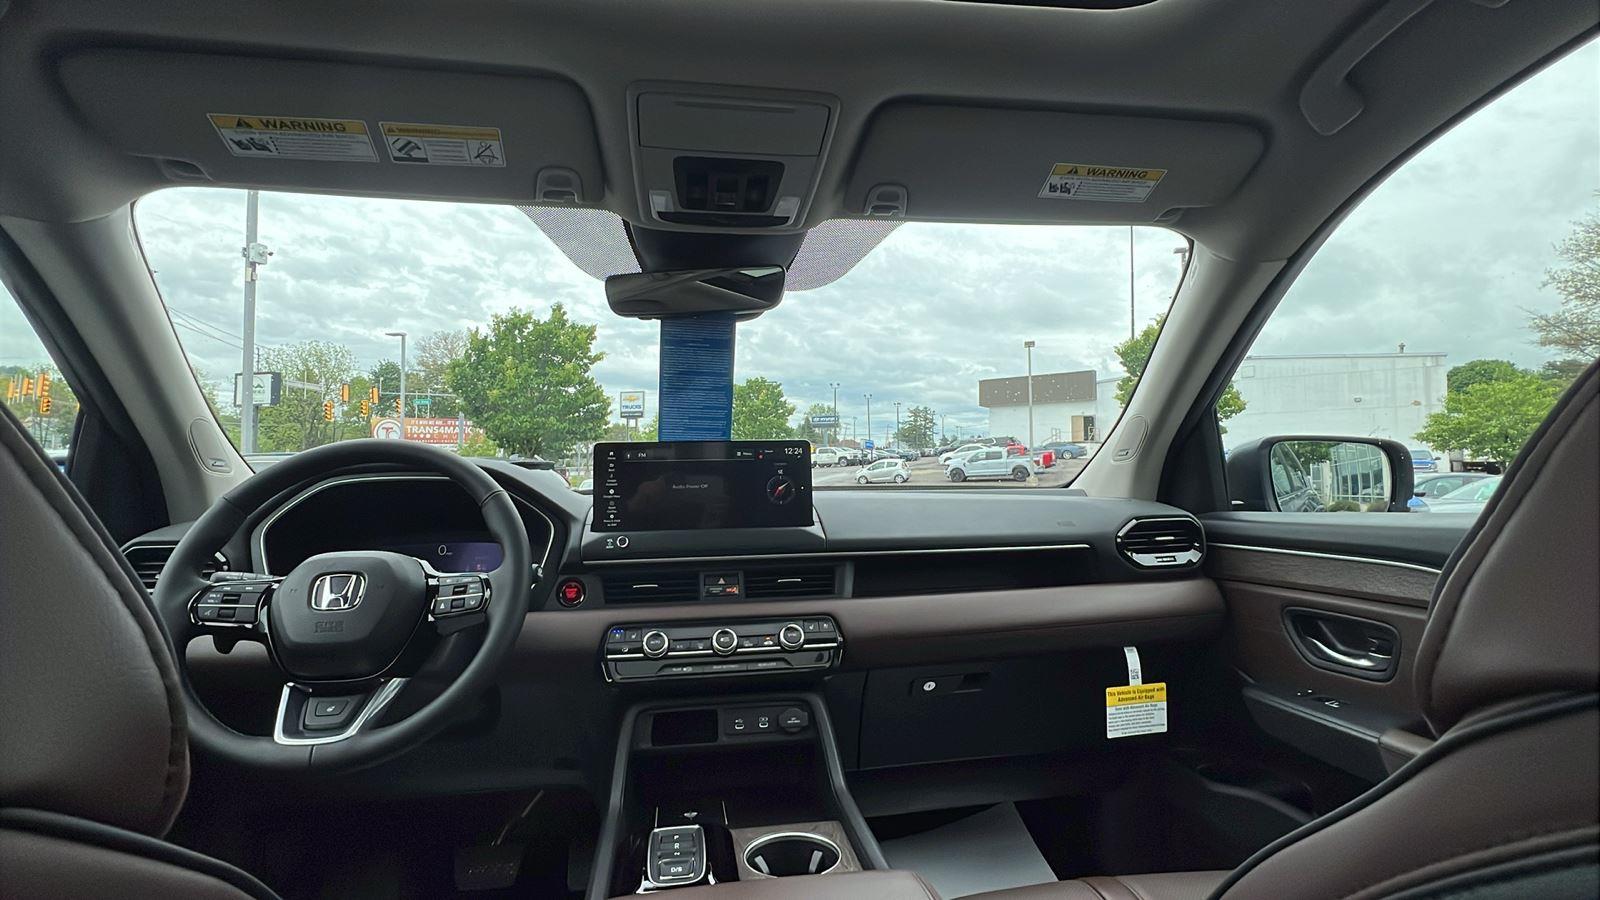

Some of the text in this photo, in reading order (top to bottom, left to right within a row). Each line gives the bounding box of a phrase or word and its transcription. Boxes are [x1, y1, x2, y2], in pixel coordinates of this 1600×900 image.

[259, 117, 346, 133] WARNING
[1086, 167, 1148, 179] WARNING
[406, 425, 484, 434] TRANS4MAION
[784, 447, 803, 455] 12:24
